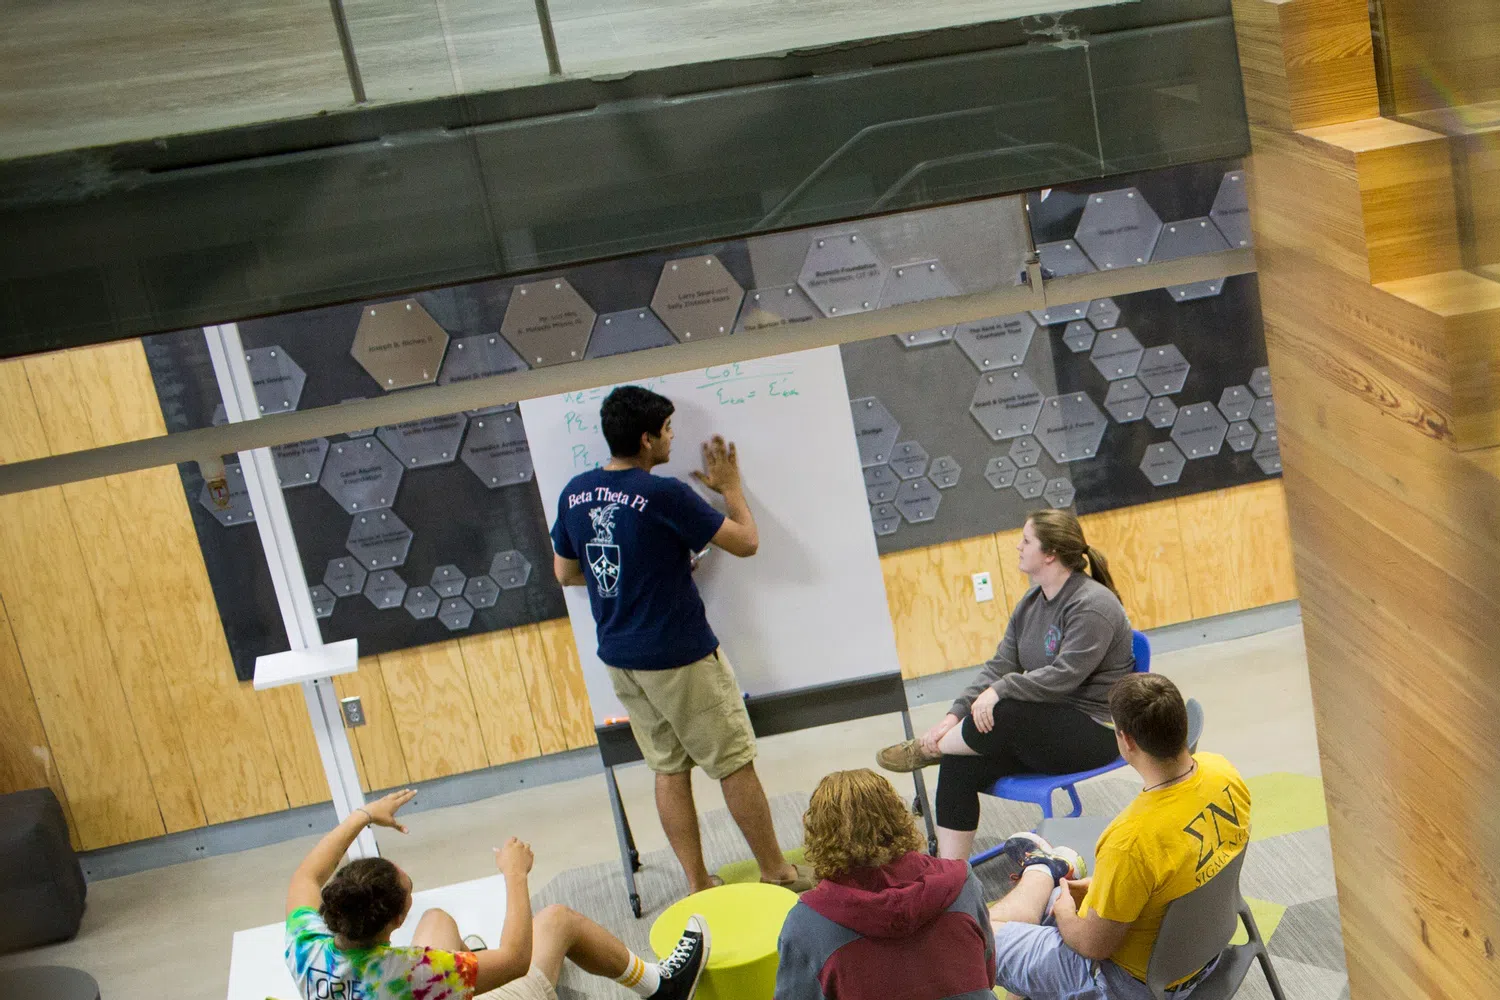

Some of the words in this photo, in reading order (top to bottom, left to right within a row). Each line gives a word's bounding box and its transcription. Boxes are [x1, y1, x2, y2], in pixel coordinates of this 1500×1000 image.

[840, 261, 876, 273] Foundation
[568, 491, 593, 509] Beta
[595, 487, 630, 505] Theta
[630, 494, 649, 512] Pi
[1195, 850, 1230, 887] SIGMA
[316, 978, 364, 1000] ORIE
